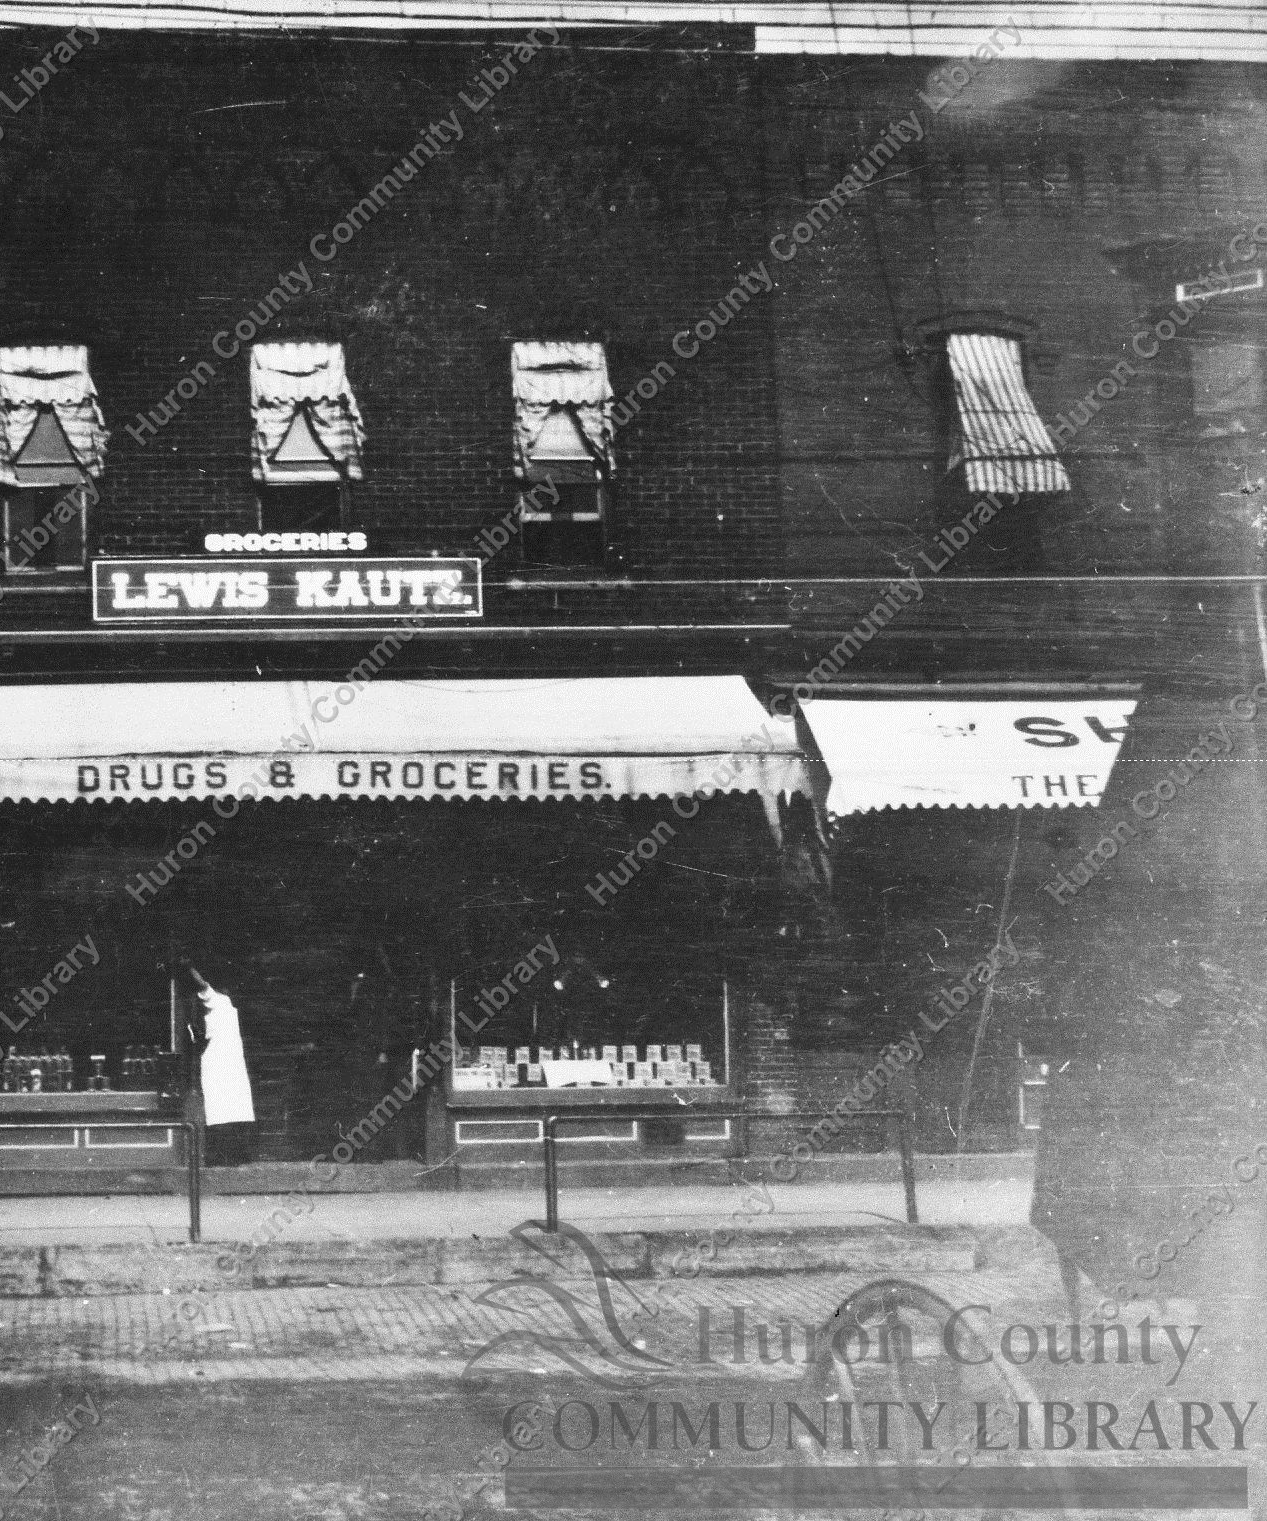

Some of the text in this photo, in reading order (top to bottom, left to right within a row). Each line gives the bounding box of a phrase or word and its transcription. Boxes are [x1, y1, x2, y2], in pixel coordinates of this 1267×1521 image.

[204, 532, 368, 552] GROCERIES
[111, 571, 270, 610] LEWIS
[77, 760, 612, 793] DRUGS & GROCERIES.
[1011, 774, 1104, 798] THE
